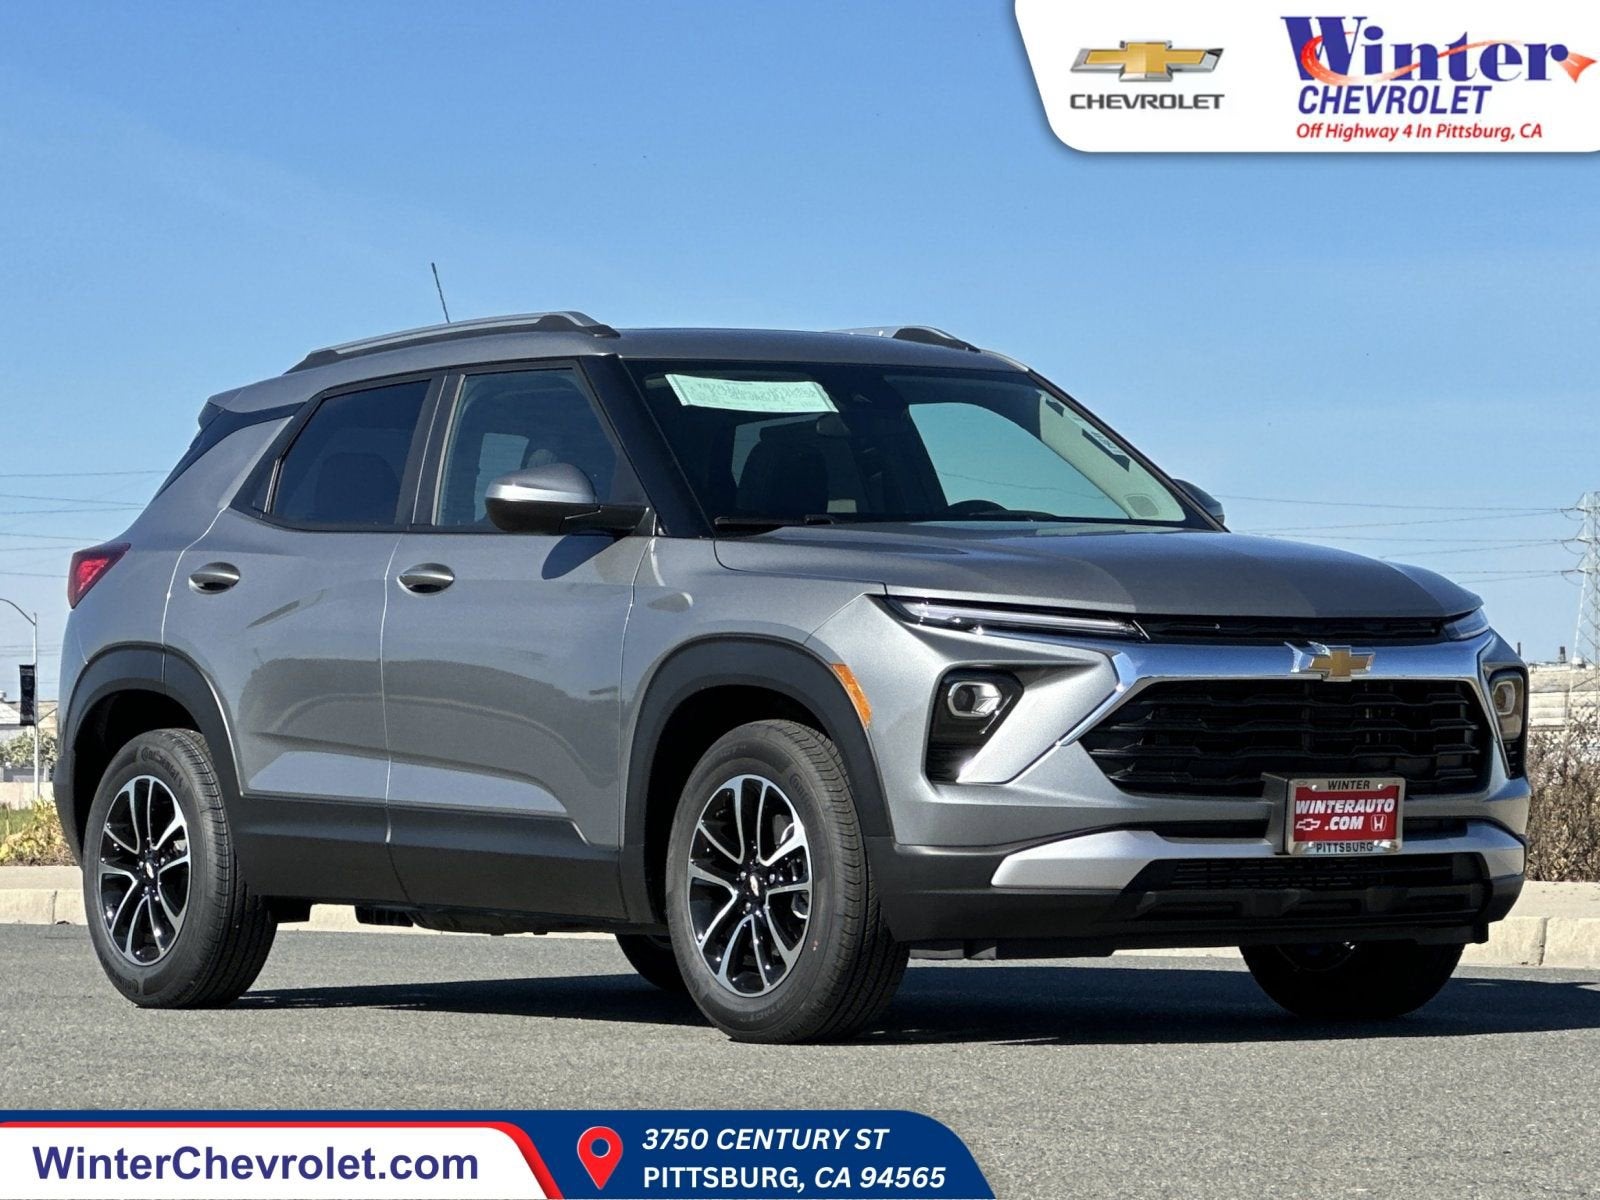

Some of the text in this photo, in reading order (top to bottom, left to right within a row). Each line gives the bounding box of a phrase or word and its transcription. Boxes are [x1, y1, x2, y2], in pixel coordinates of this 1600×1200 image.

[1327, 780, 1371, 790] WINTER
[1295, 798, 1395, 815] WINTERAUTO
[1323, 815, 1365, 831] .COM
[1316, 841, 1374, 853] PITTSBURG
